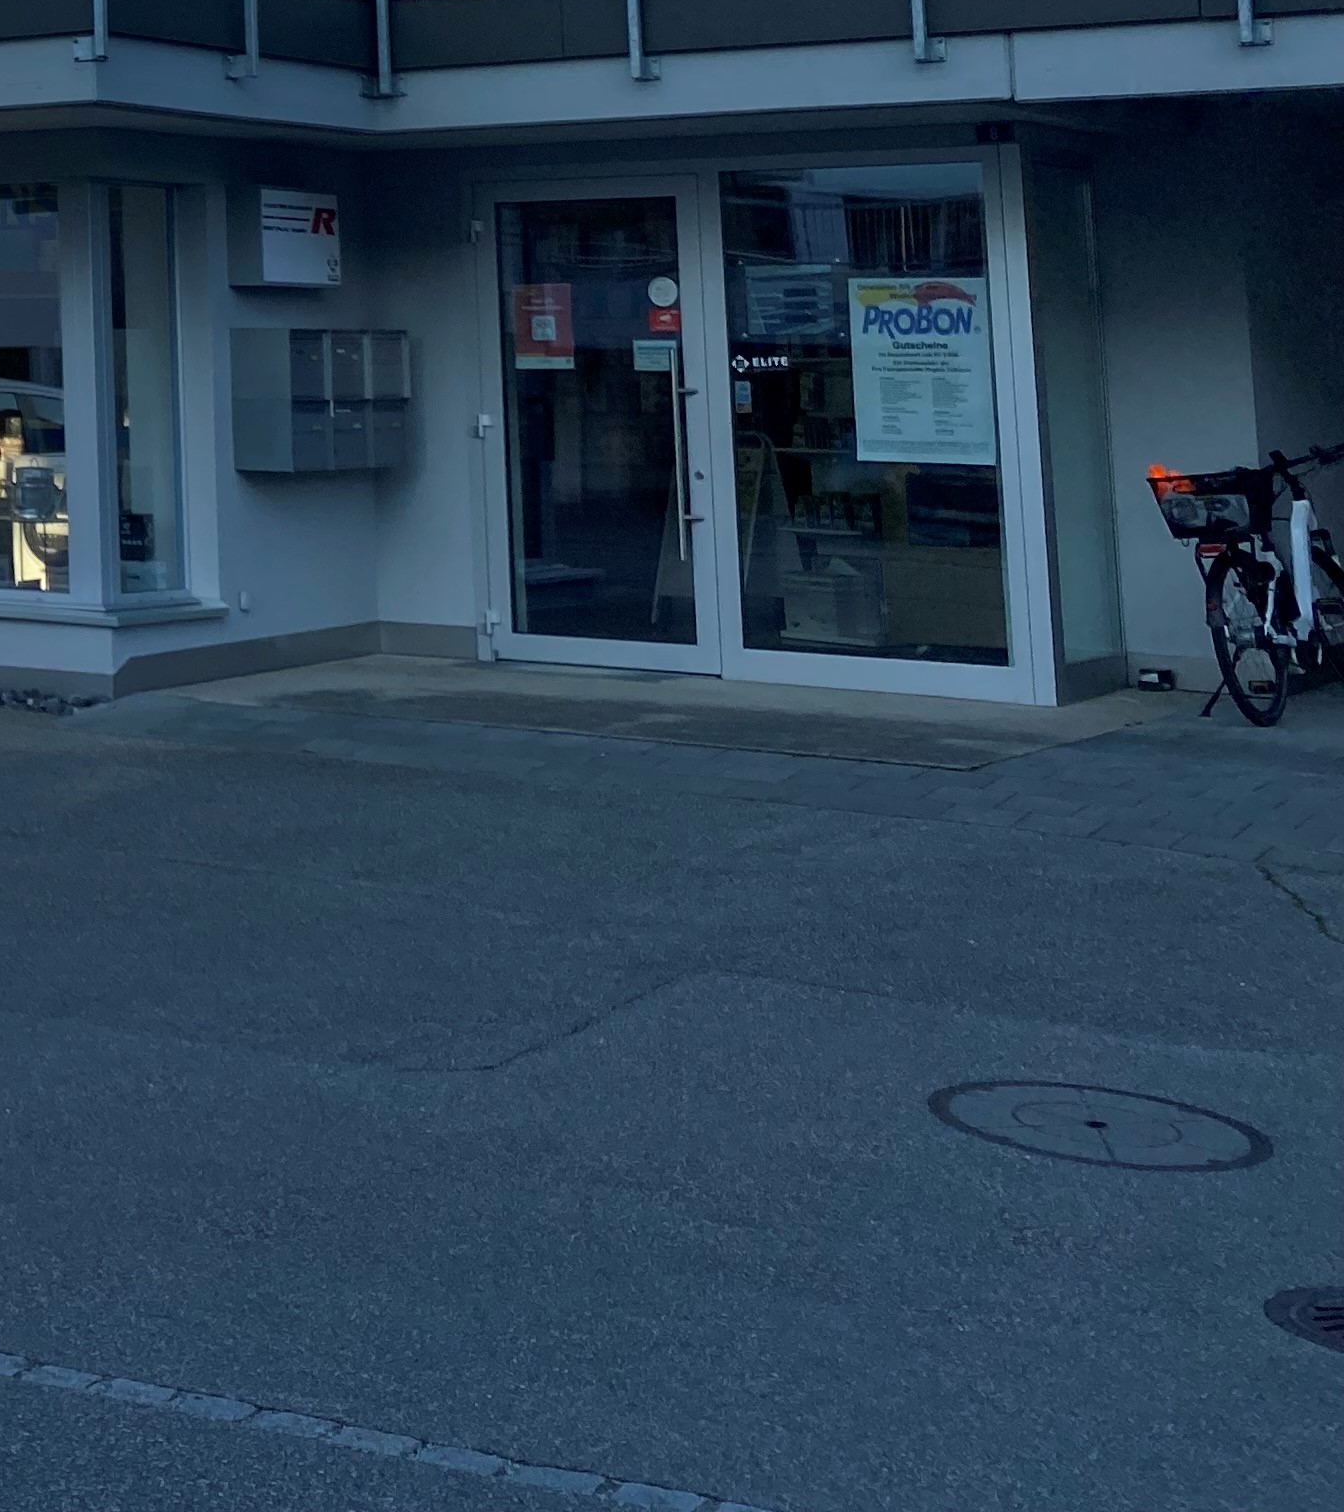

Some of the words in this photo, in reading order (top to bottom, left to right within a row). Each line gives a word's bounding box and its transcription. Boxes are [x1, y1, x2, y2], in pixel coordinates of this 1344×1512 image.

[862, 304, 973, 339] PROBON
[892, 341, 949, 350] Gutscheine
[752, 356, 789, 367] ELITE
